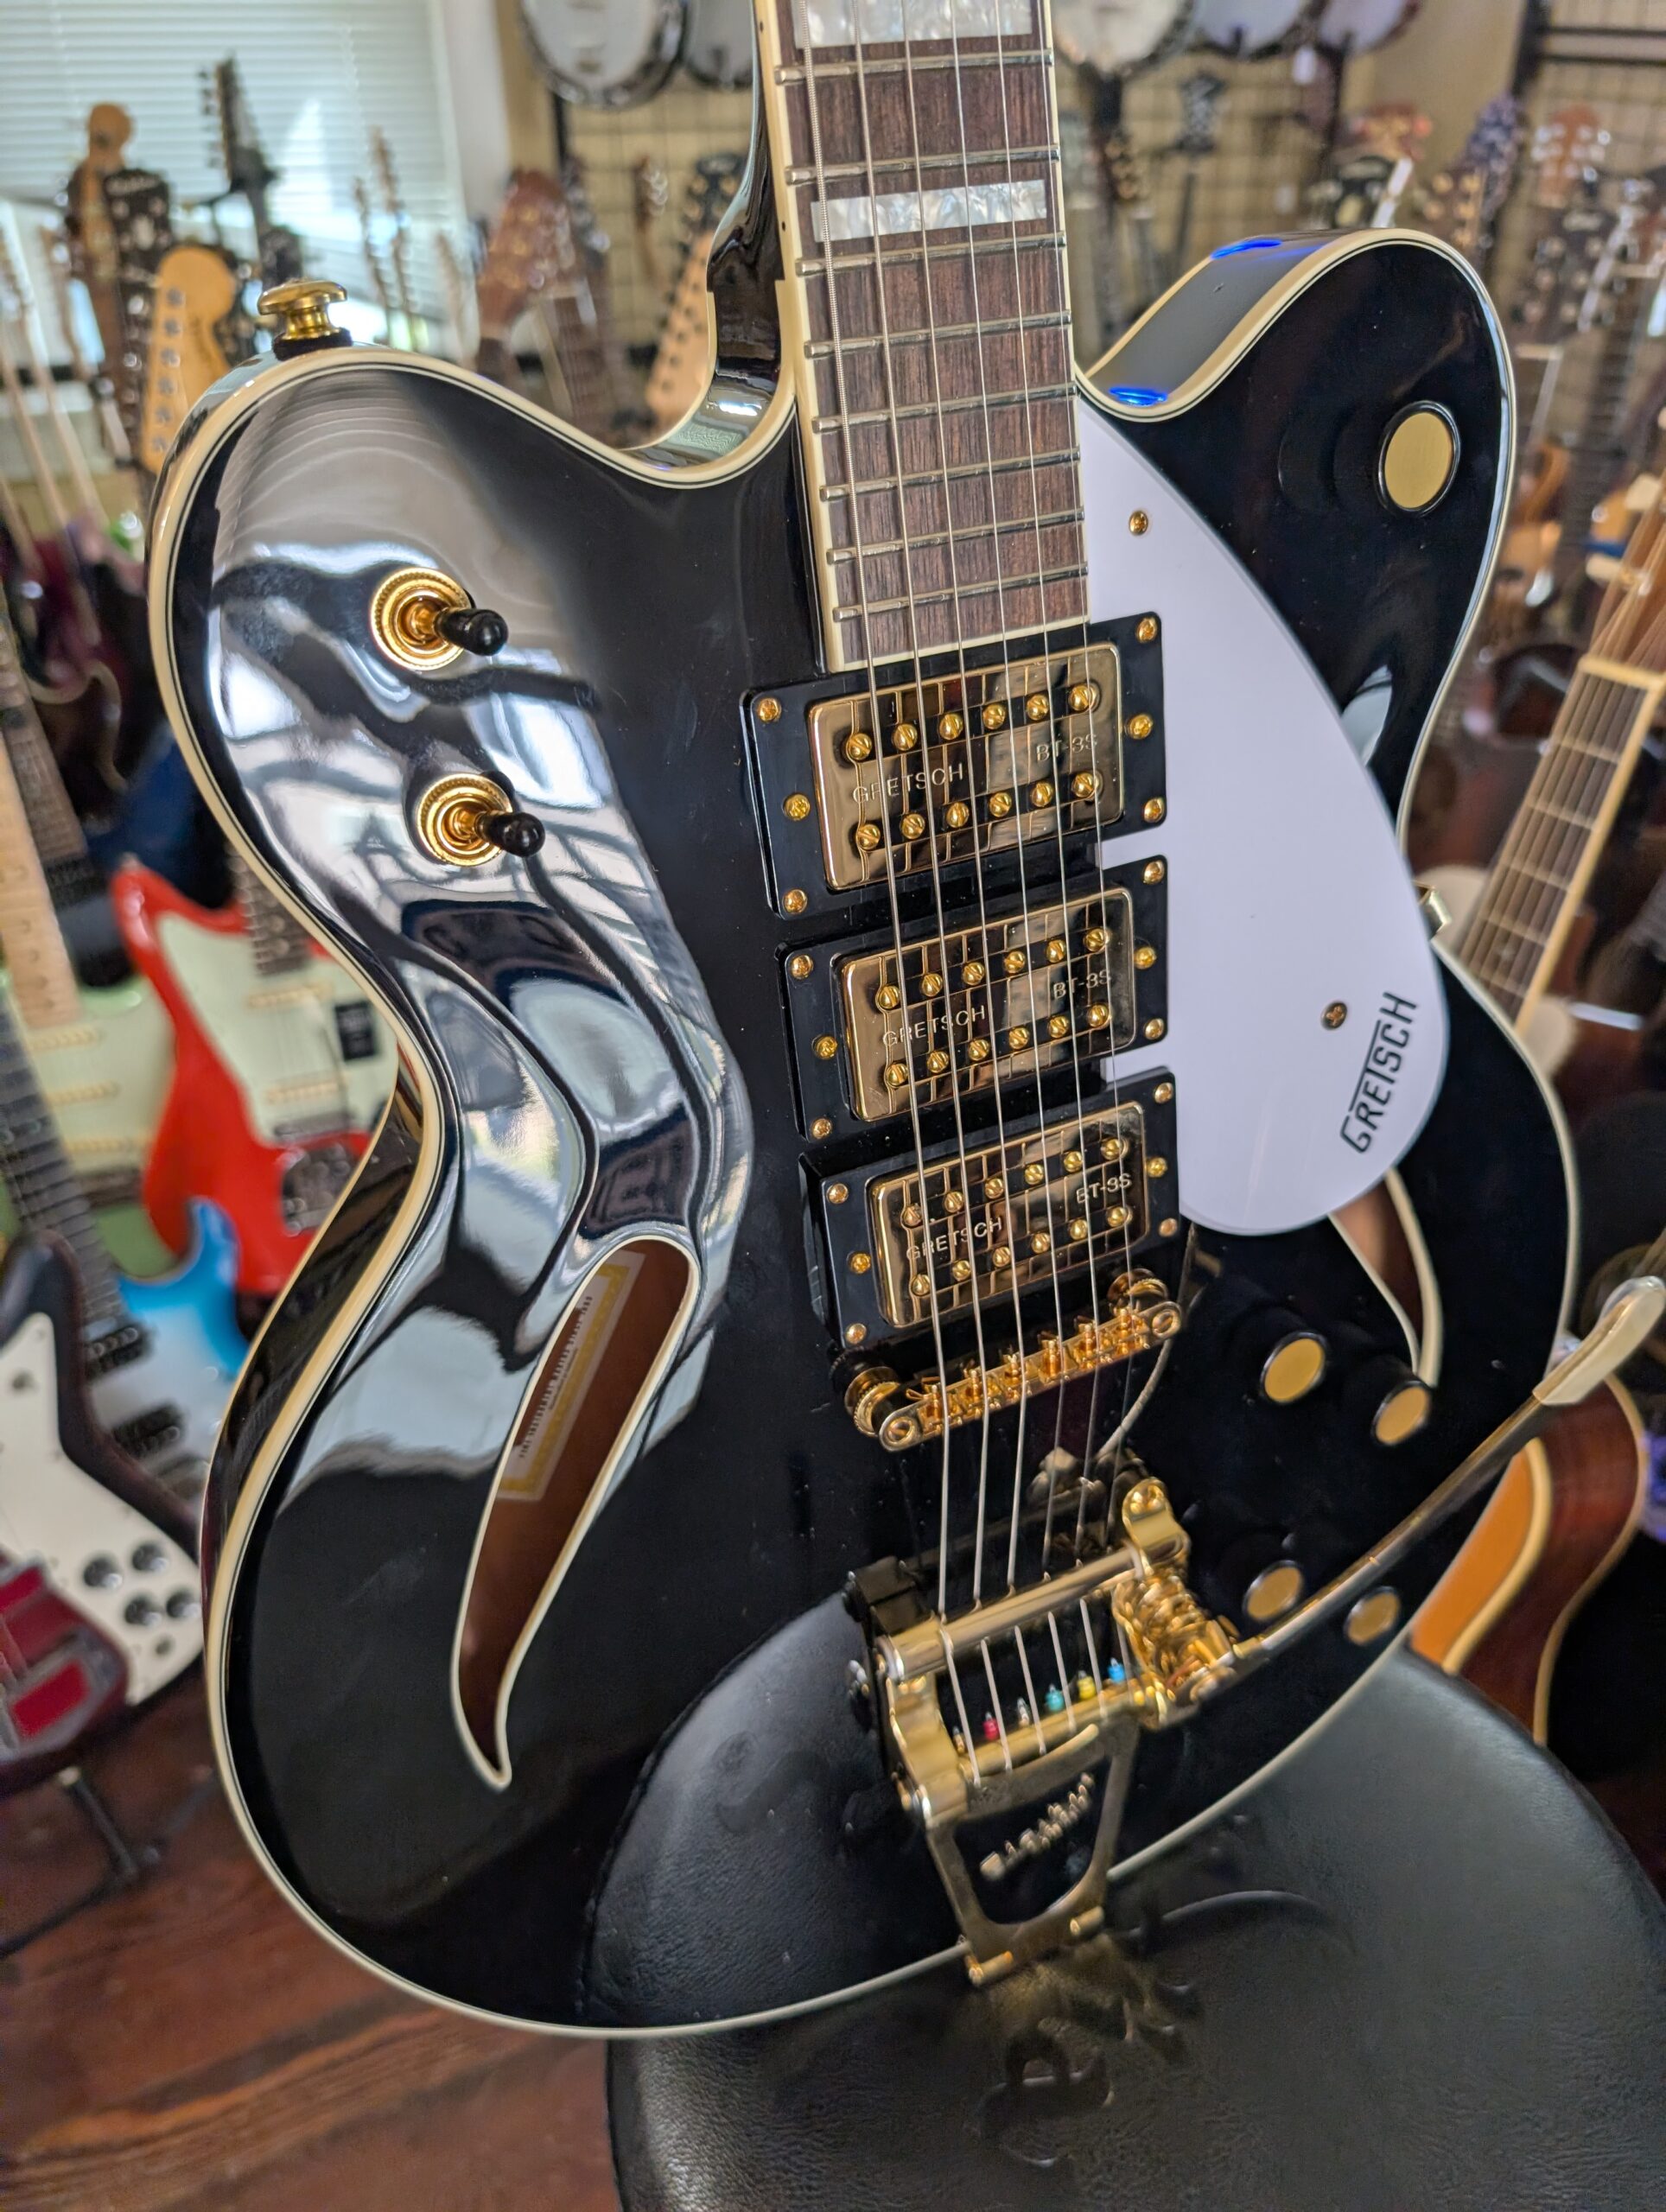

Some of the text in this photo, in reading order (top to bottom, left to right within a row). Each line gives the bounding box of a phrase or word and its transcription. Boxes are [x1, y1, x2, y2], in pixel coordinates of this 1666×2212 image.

[852, 733, 1098, 804] GRETSCH BT-3S
[882, 969, 1112, 1046] GRETSCH BT-3S
[1339, 991, 1417, 1154] GRETSCH
[906, 1173, 1133, 1261] GRETSCH BT-3S
